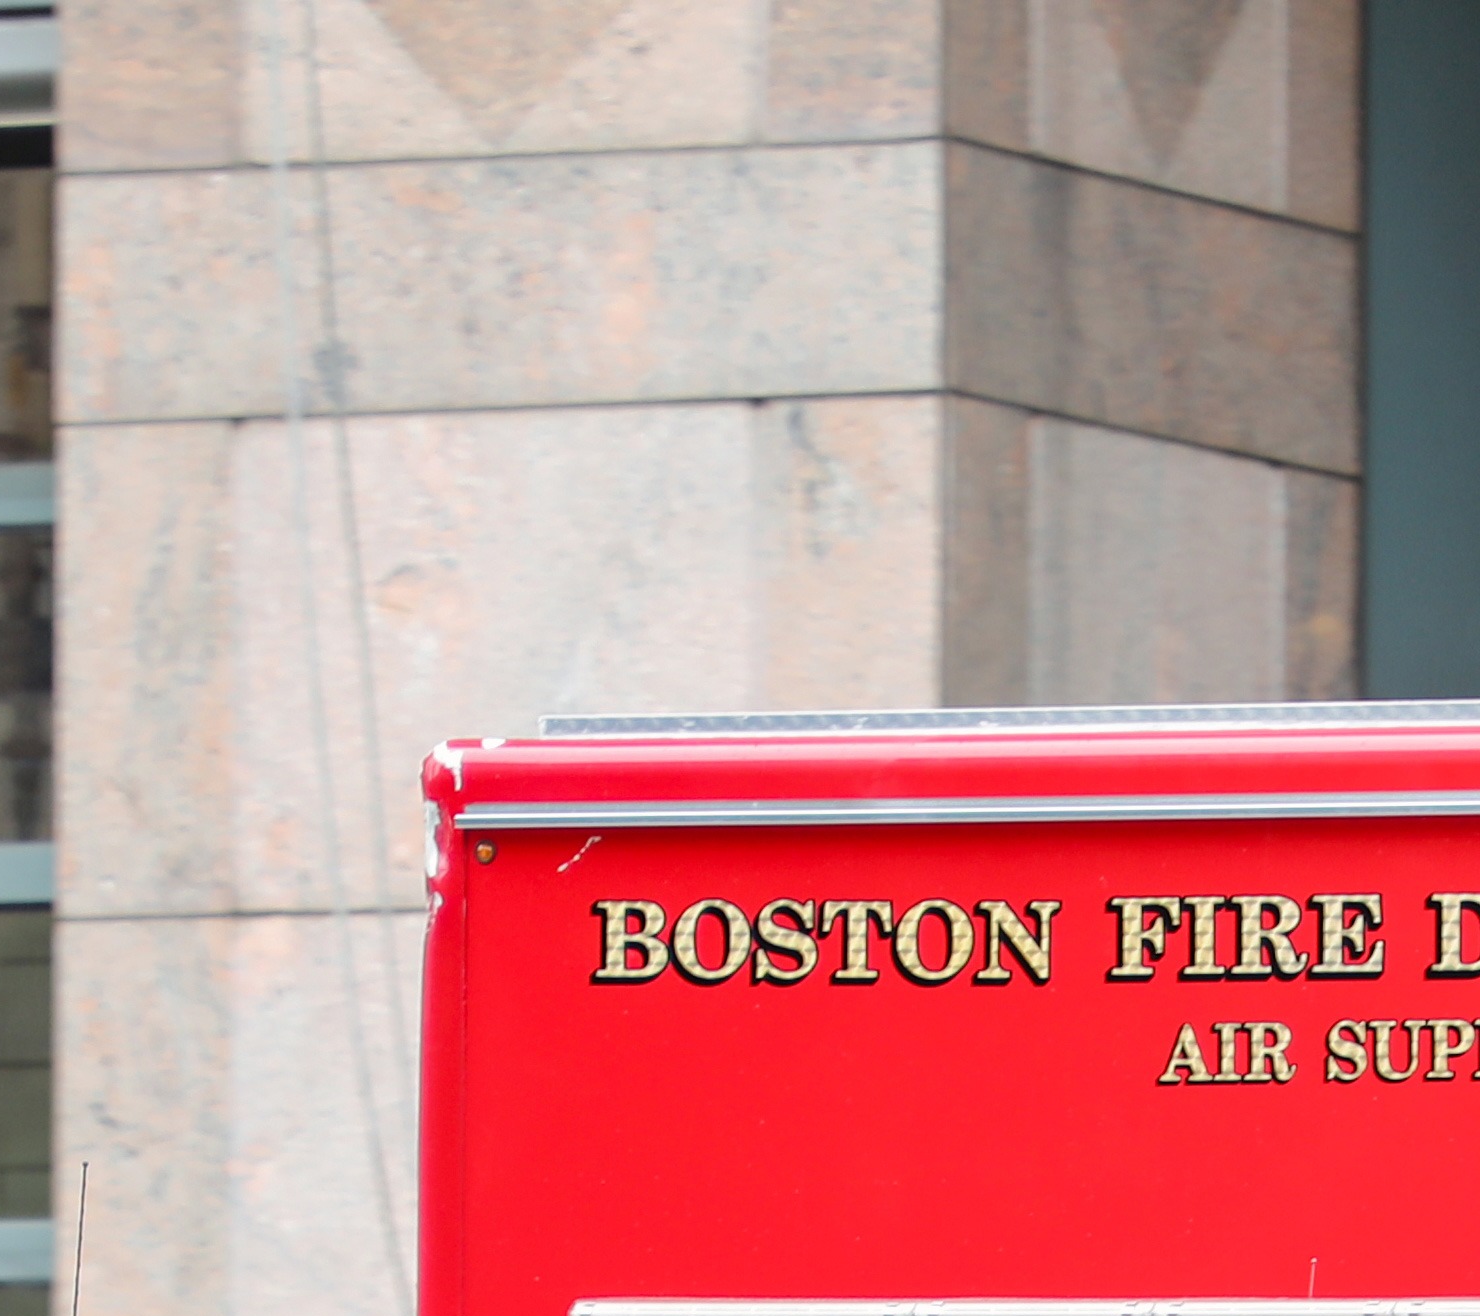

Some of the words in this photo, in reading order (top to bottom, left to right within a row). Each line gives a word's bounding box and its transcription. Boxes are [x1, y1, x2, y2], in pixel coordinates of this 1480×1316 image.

[591, 900, 1061, 986] BOSTON
[1106, 894, 1385, 982] FIRE
[1158, 1022, 1297, 1085] AIR
